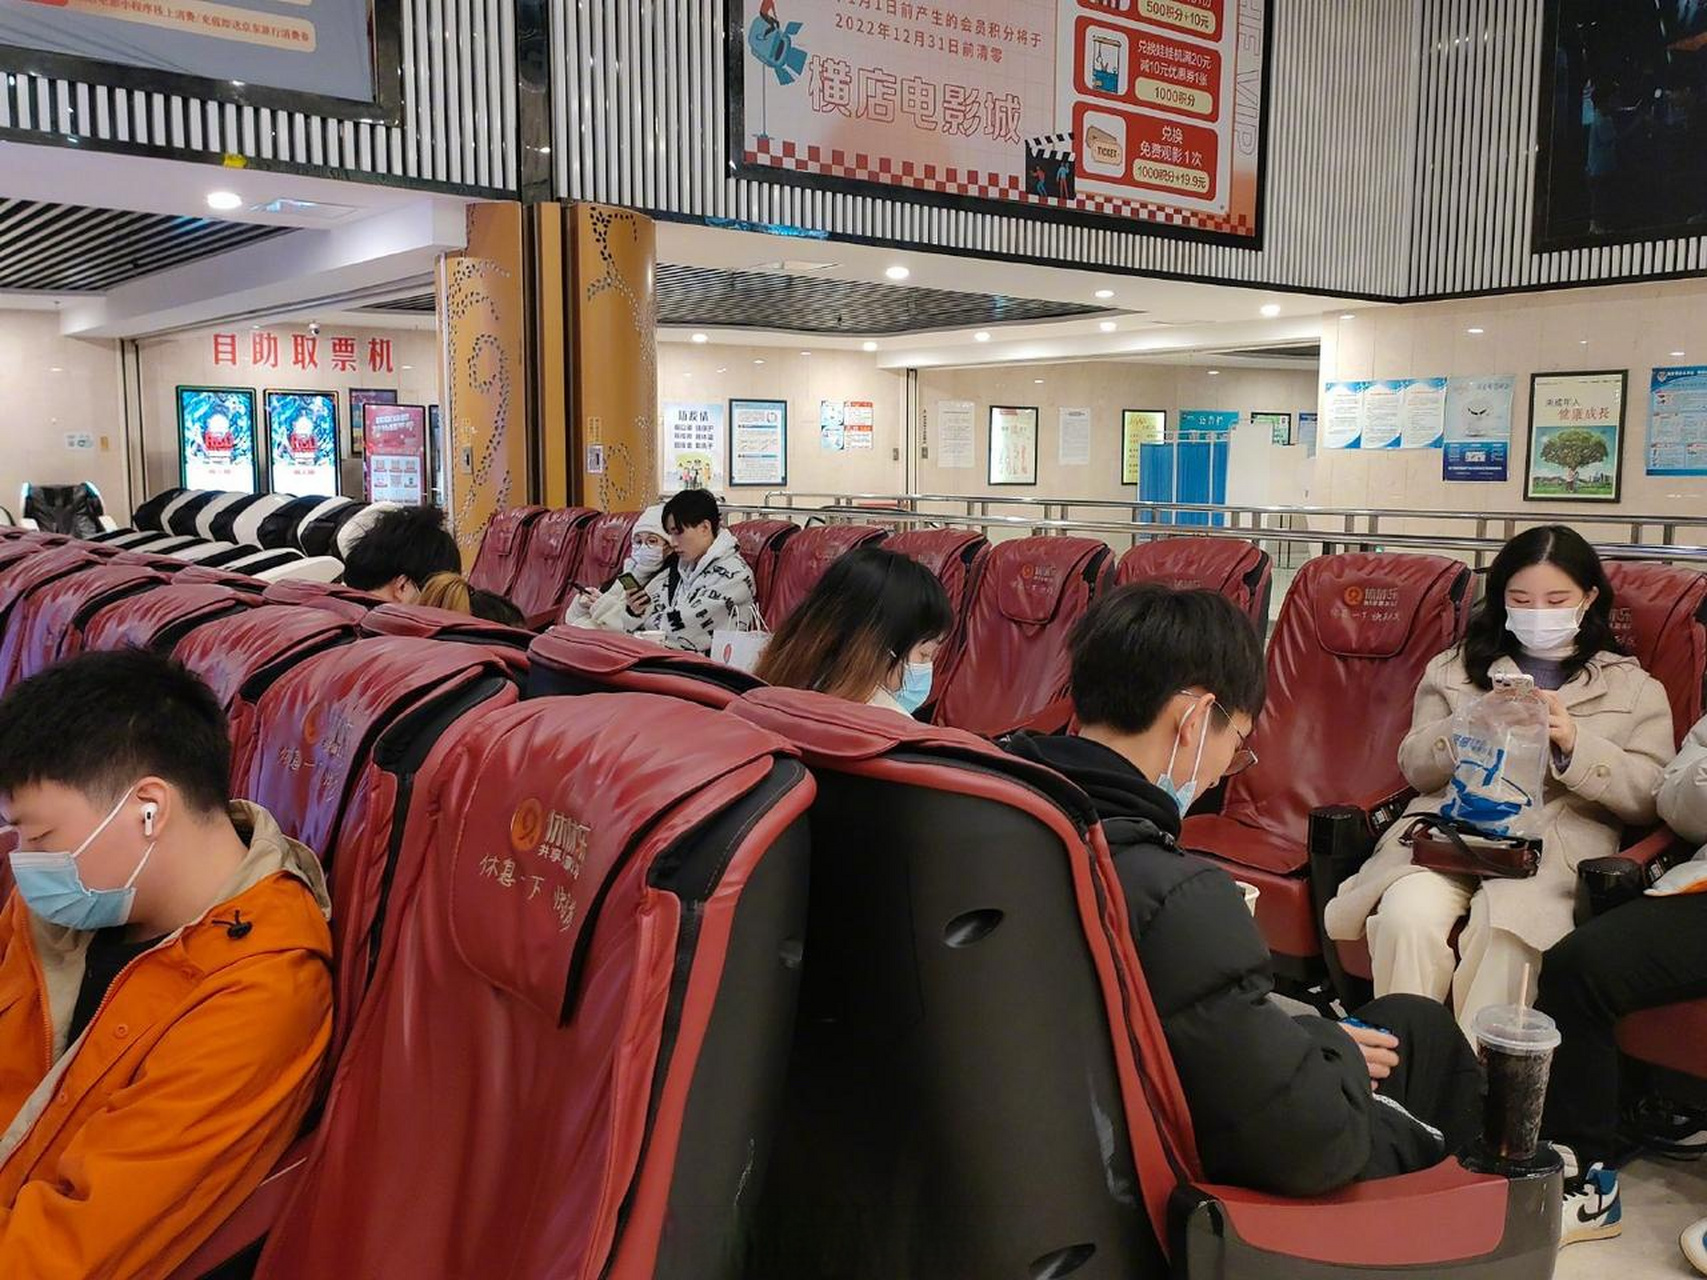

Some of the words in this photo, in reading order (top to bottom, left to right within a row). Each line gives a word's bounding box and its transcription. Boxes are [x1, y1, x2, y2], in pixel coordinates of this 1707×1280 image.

[835, 13, 1003, 63] 2022年12月31日前清零
[807, 54, 1024, 144] 横店电影城
[1155, 87, 1196, 107] 1000积分
[1162, 125, 1184, 144] 兑换
[1096, 146, 1118, 158] TICKET
[1140, 140, 1203, 167] 免费观影1次
[212, 332, 394, 373] 自助取票机
[1558, 406, 1610, 422] 健康成长
